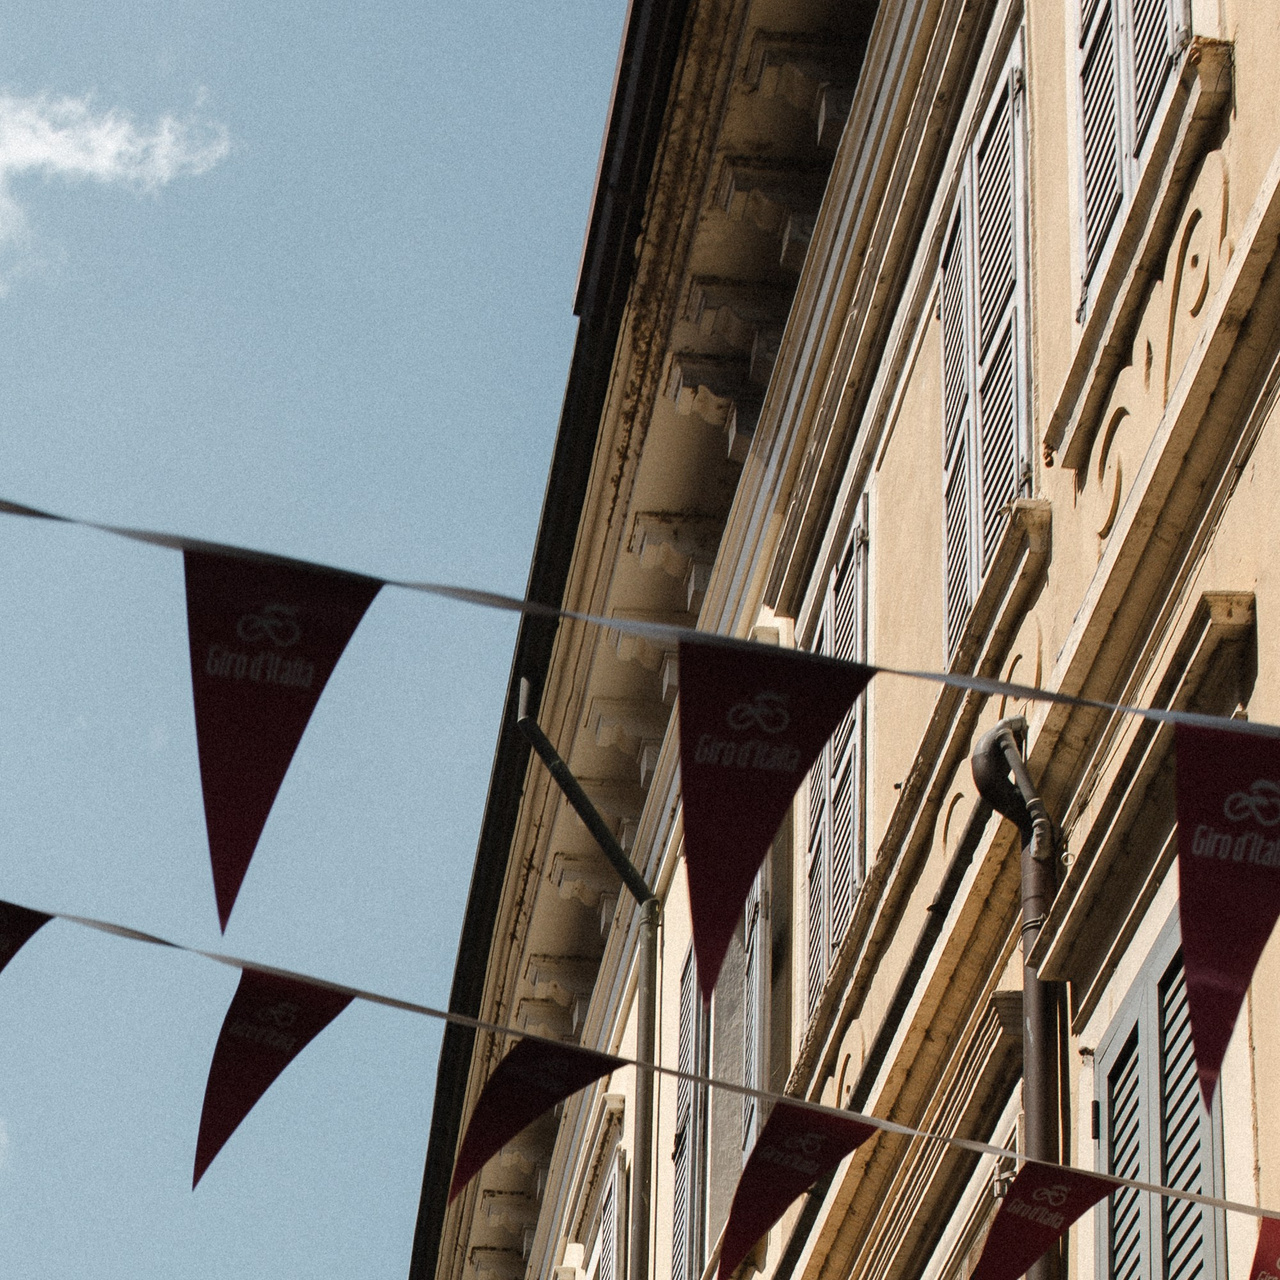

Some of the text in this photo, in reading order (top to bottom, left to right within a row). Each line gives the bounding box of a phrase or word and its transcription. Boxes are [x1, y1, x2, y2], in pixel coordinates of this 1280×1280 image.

[206, 643, 316, 690] Giro d'Italia
[694, 733, 802, 774] Giro d'Italia
[1191, 824, 1232, 860] Giro
